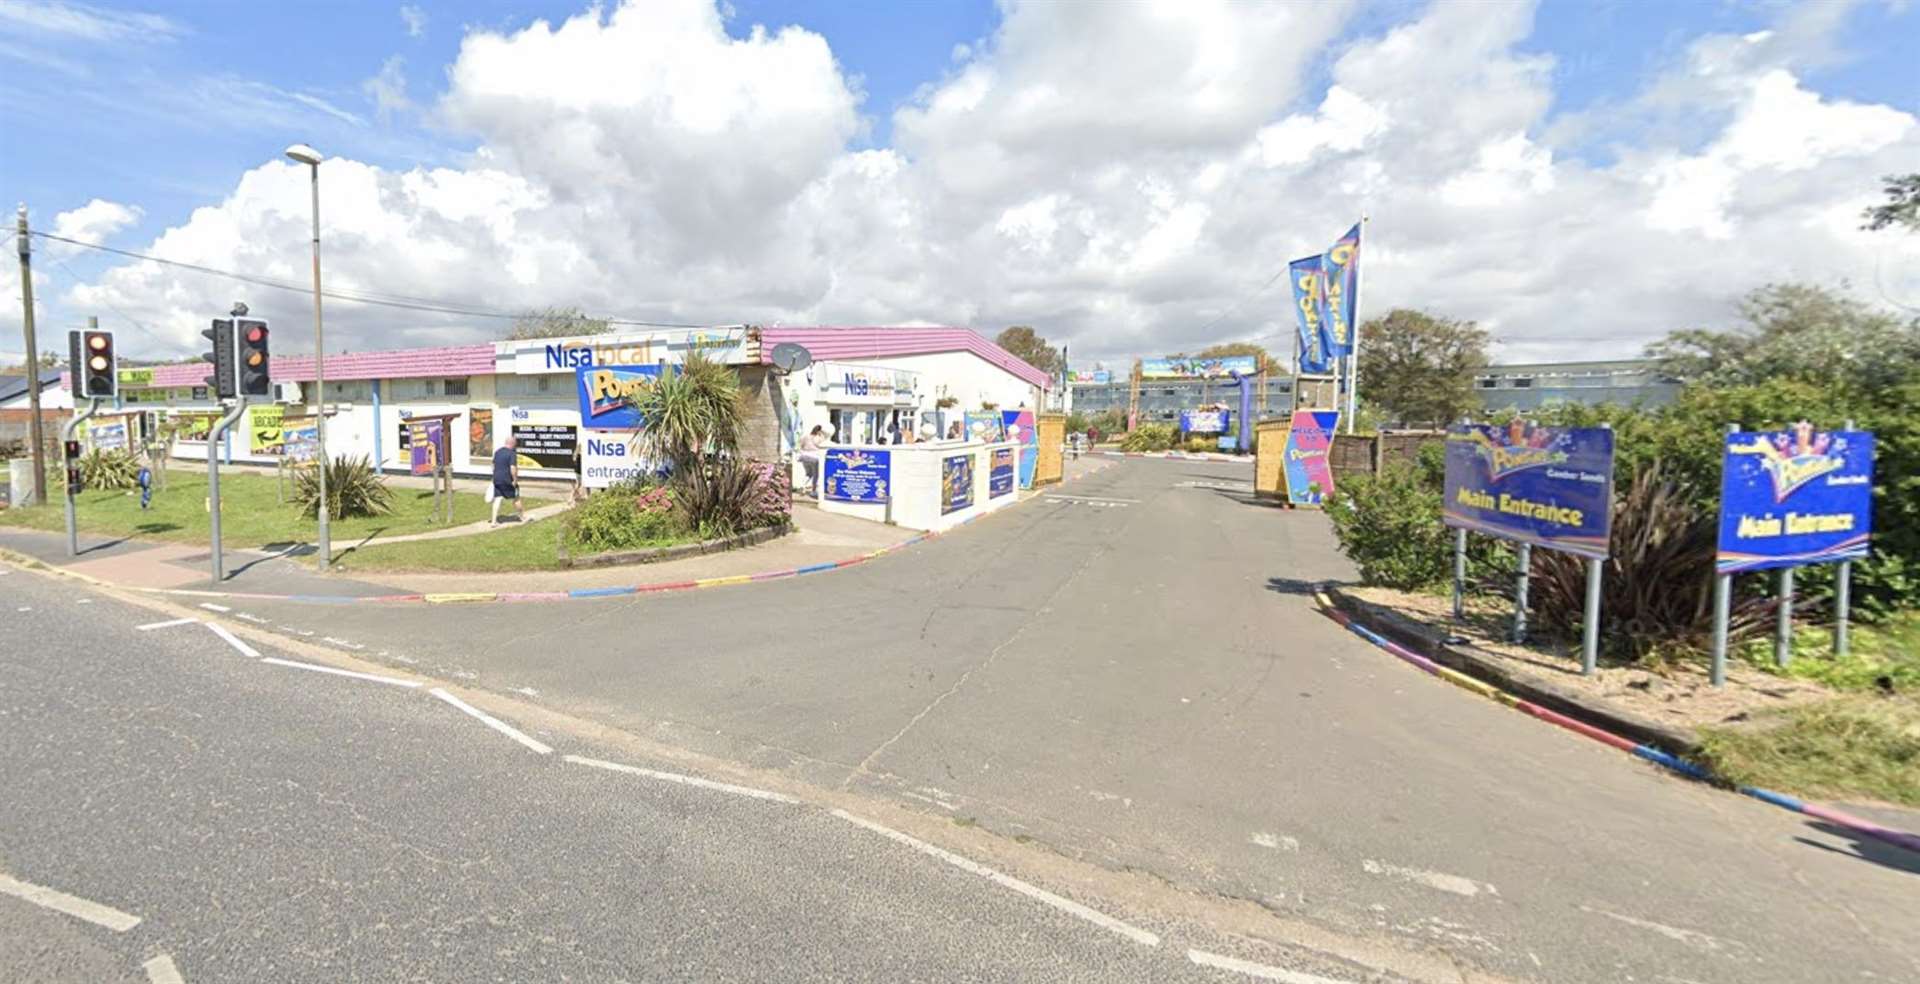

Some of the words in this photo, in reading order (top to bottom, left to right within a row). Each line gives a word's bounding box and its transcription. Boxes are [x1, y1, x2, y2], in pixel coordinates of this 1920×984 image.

[546, 344, 593, 368] Nisa
[595, 339, 651, 365] local
[845, 373, 868, 396] Nisa
[512, 408, 529, 419] Nisa
[587, 439, 625, 456] Nisa
[1458, 486, 1495, 509] Main
[1499, 493, 1584, 526] Entrance
[1736, 512, 1782, 539] Main
[1785, 511, 1855, 536] Entrance
